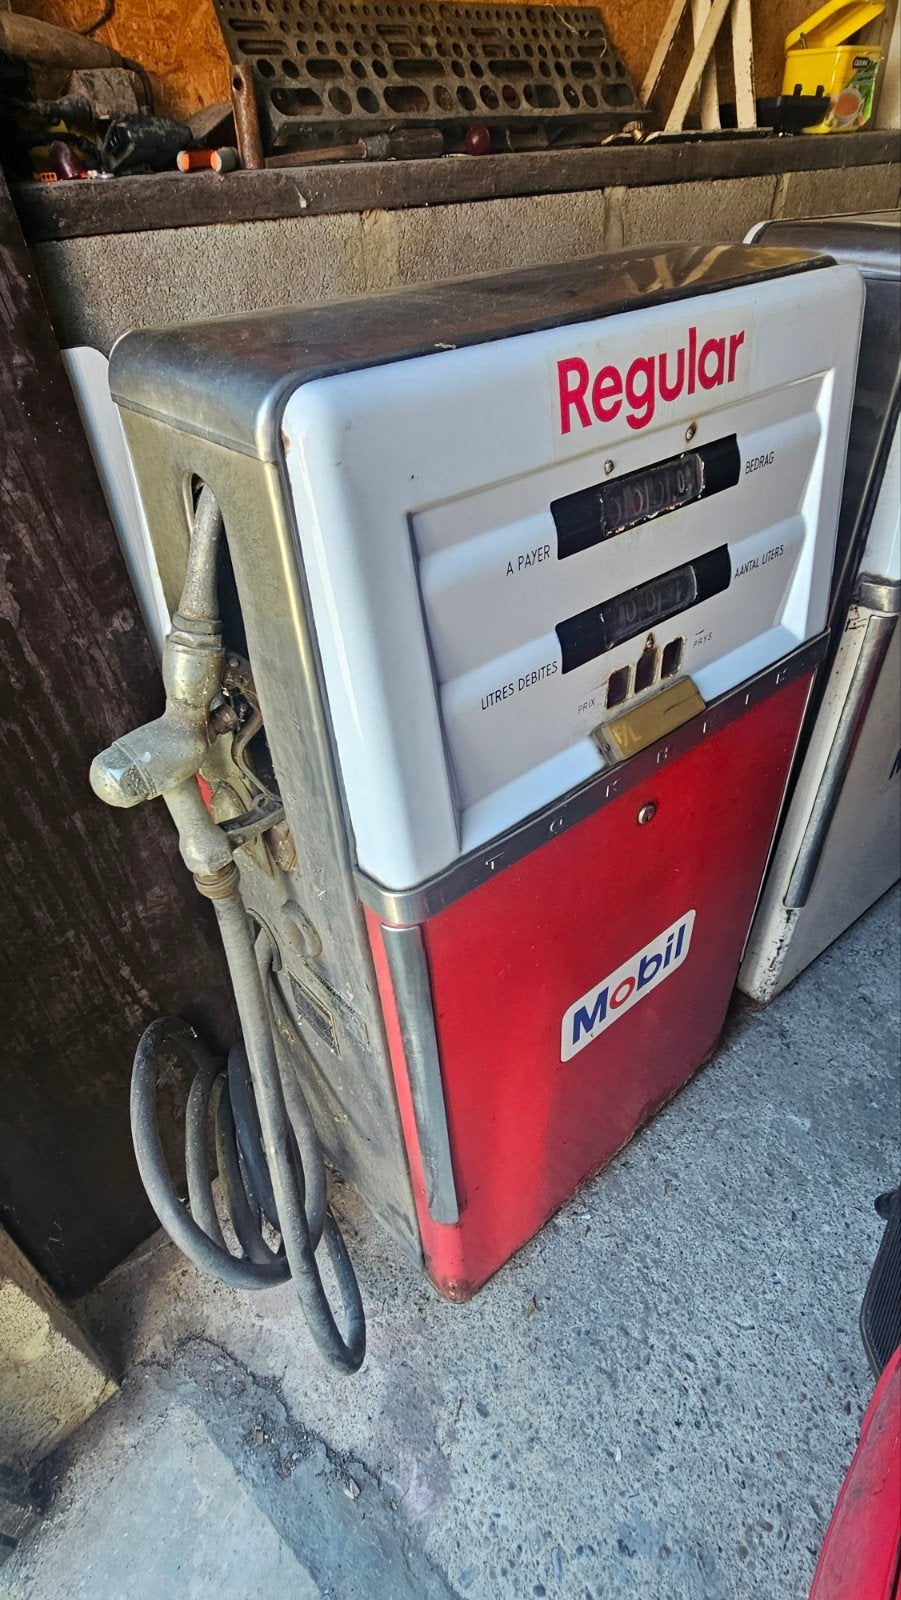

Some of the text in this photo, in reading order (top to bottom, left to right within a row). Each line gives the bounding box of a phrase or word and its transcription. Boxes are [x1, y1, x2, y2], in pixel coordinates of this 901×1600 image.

[557, 327, 745, 435] Regular
[744, 451, 775, 475] BEDRAG
[506, 545, 551, 576] A PAYER
[734, 545, 784, 579] AANTAL LITERS
[692, 632, 713, 649] PRYS
[481, 661, 558, 710] LITRES DEBITES
[577, 697, 597, 714] PRIX
[572, 923, 686, 1046] Mobil
